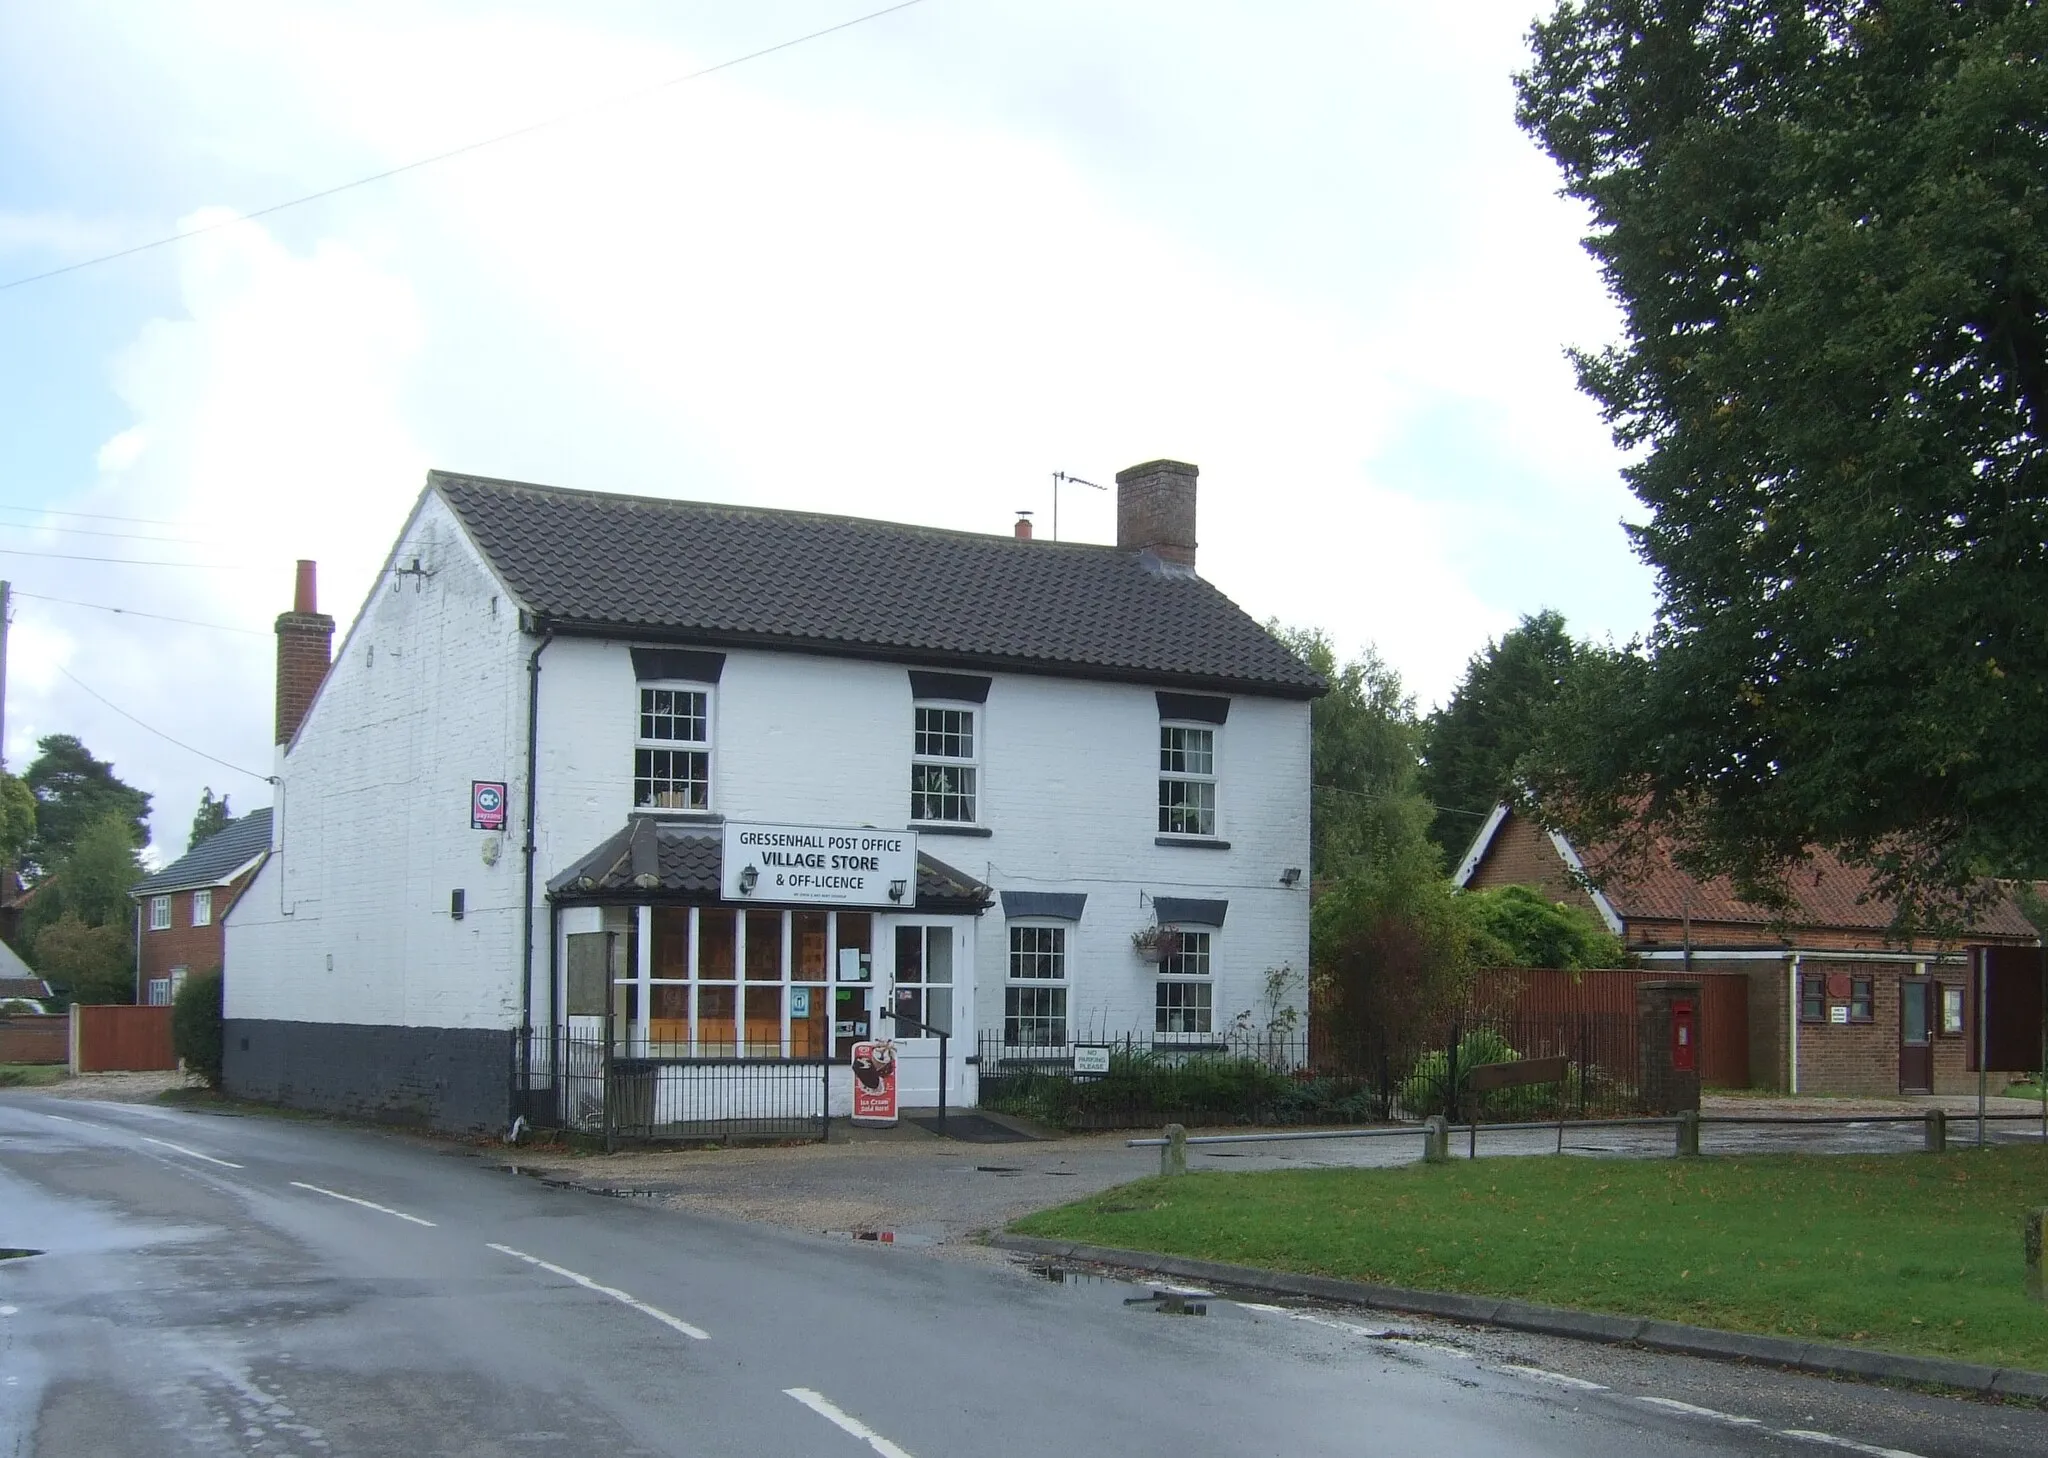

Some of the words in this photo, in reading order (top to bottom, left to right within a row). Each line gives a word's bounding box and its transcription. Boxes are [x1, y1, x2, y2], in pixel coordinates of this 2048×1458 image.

[740, 832, 825, 848] GRESSENHALL
[828, 836, 858, 850] POST
[861, 838, 902, 852] OFFICE
[762, 851, 825, 868] VILLAGE
[831, 855, 879, 871] STORE
[776, 874, 785, 886] &
[788, 874, 864, 889] OFF-LICENCE
